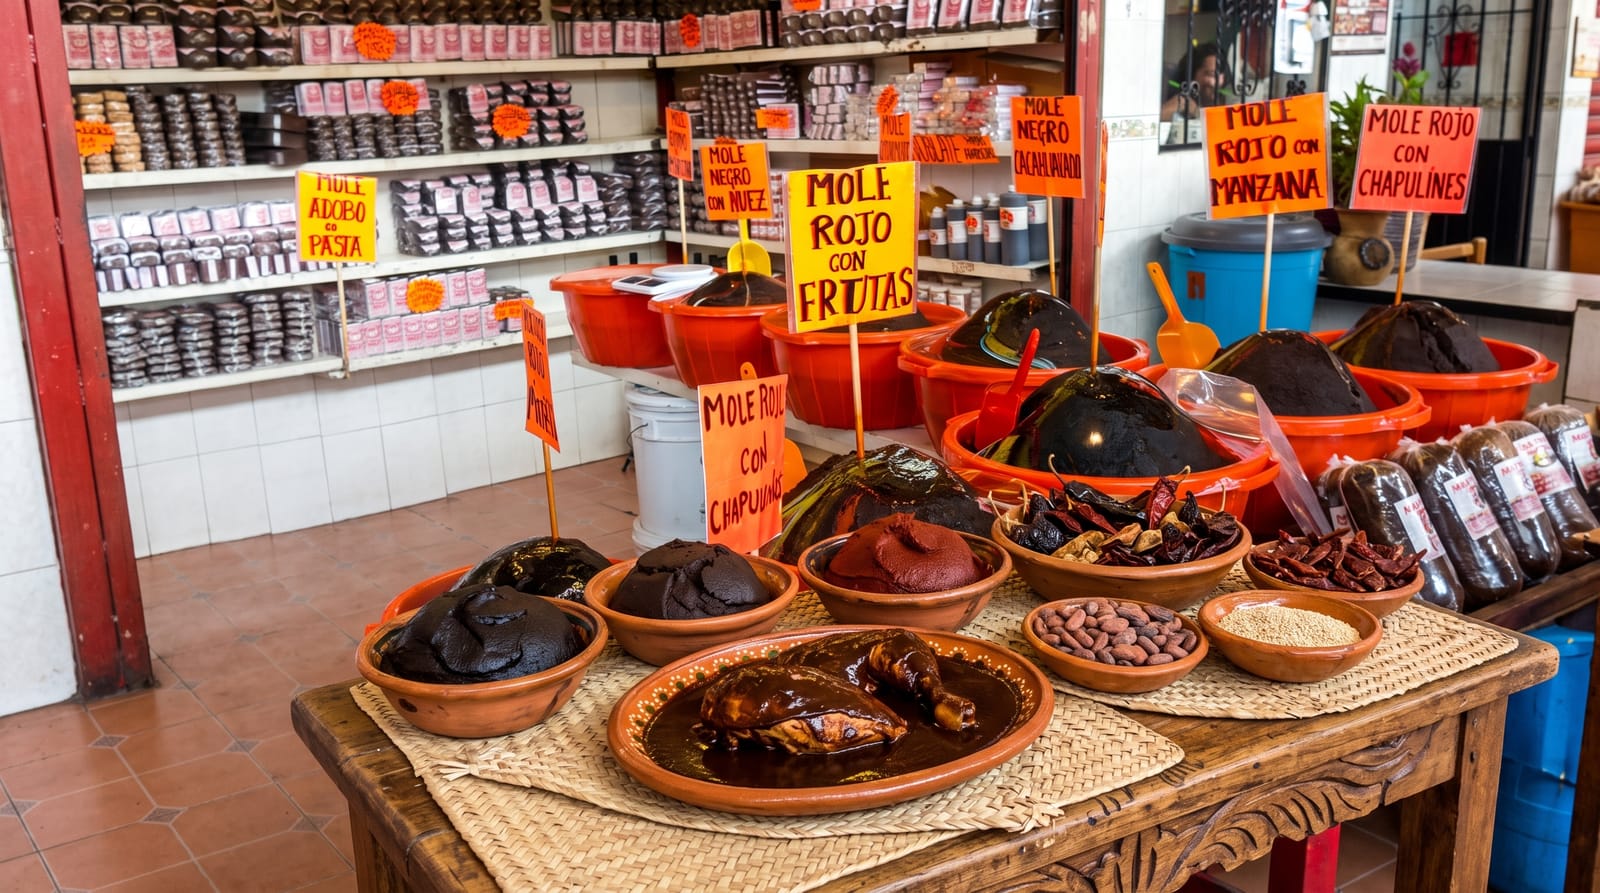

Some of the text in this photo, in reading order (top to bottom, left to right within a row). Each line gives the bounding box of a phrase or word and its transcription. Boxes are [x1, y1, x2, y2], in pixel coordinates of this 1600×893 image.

[1024, 97, 1064, 117] MOLE
[1225, 99, 1297, 130] MOLE
[1017, 119, 1069, 147] NEGRO
[1368, 107, 1474, 141] MOLE ROJO
[709, 145, 746, 164] MOLE
[1214, 135, 1320, 167] ROJO CON
[1393, 144, 1430, 163] CON
[317, 173, 366, 196] MOLE
[709, 167, 751, 190] NEGRO
[806, 167, 891, 207] MOLE
[1210, 168, 1324, 207] MANZANA
[309, 197, 366, 223] ADOBO
[707, 189, 768, 212] CON NUEZ
[810, 210, 892, 249] ROJO
[308, 234, 362, 257] PASTA
[829, 250, 867, 272] CON
[799, 267, 913, 322] FRUTAS
[703, 390, 755, 432] MOLE
[740, 430, 768, 476] CON
